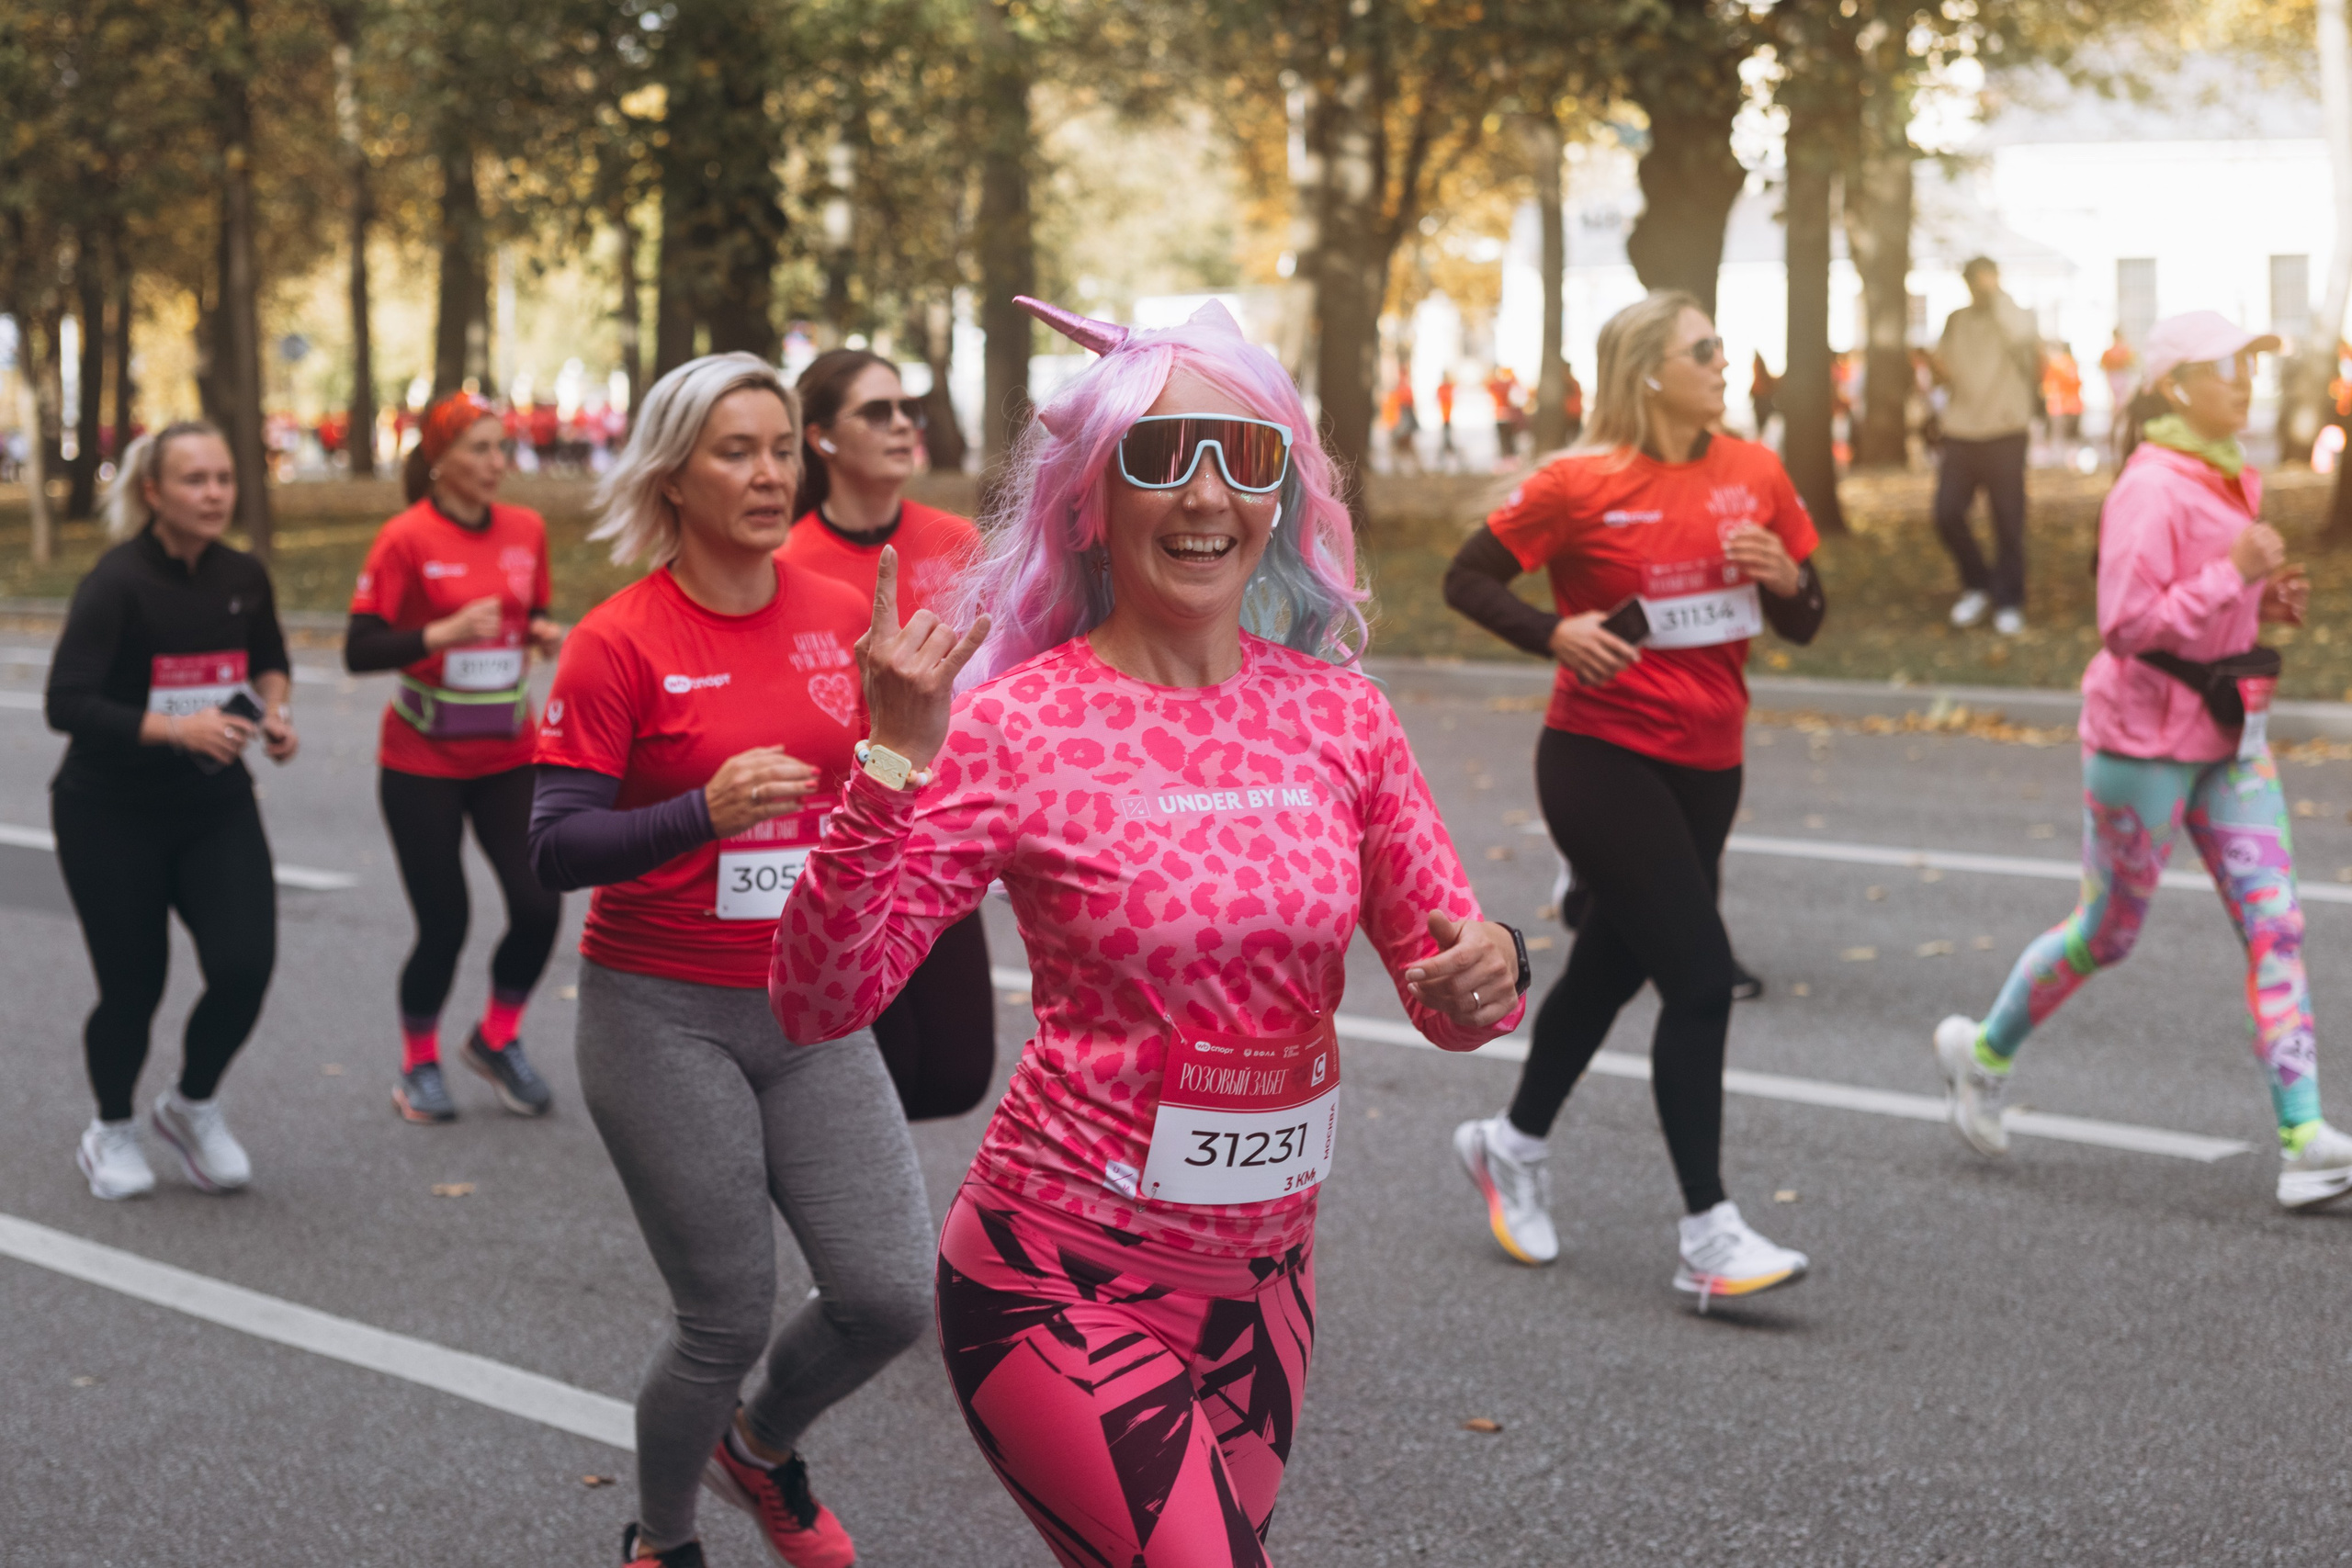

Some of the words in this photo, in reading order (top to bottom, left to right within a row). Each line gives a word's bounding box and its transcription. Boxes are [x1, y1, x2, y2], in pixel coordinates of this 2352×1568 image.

[1158, 792, 1244, 814] UNDER
[1247, 789, 1275, 808] BY
[1281, 788, 1312, 807] ME
[731, 864, 806, 893] 305
[1180, 1063, 1251, 1096] РОЗОВЫЙ
[1250, 1068, 1289, 1096] ЗАБЕГ
[1183, 1122, 1308, 1168] 31231
[1283, 1176, 1294, 1191] 3
